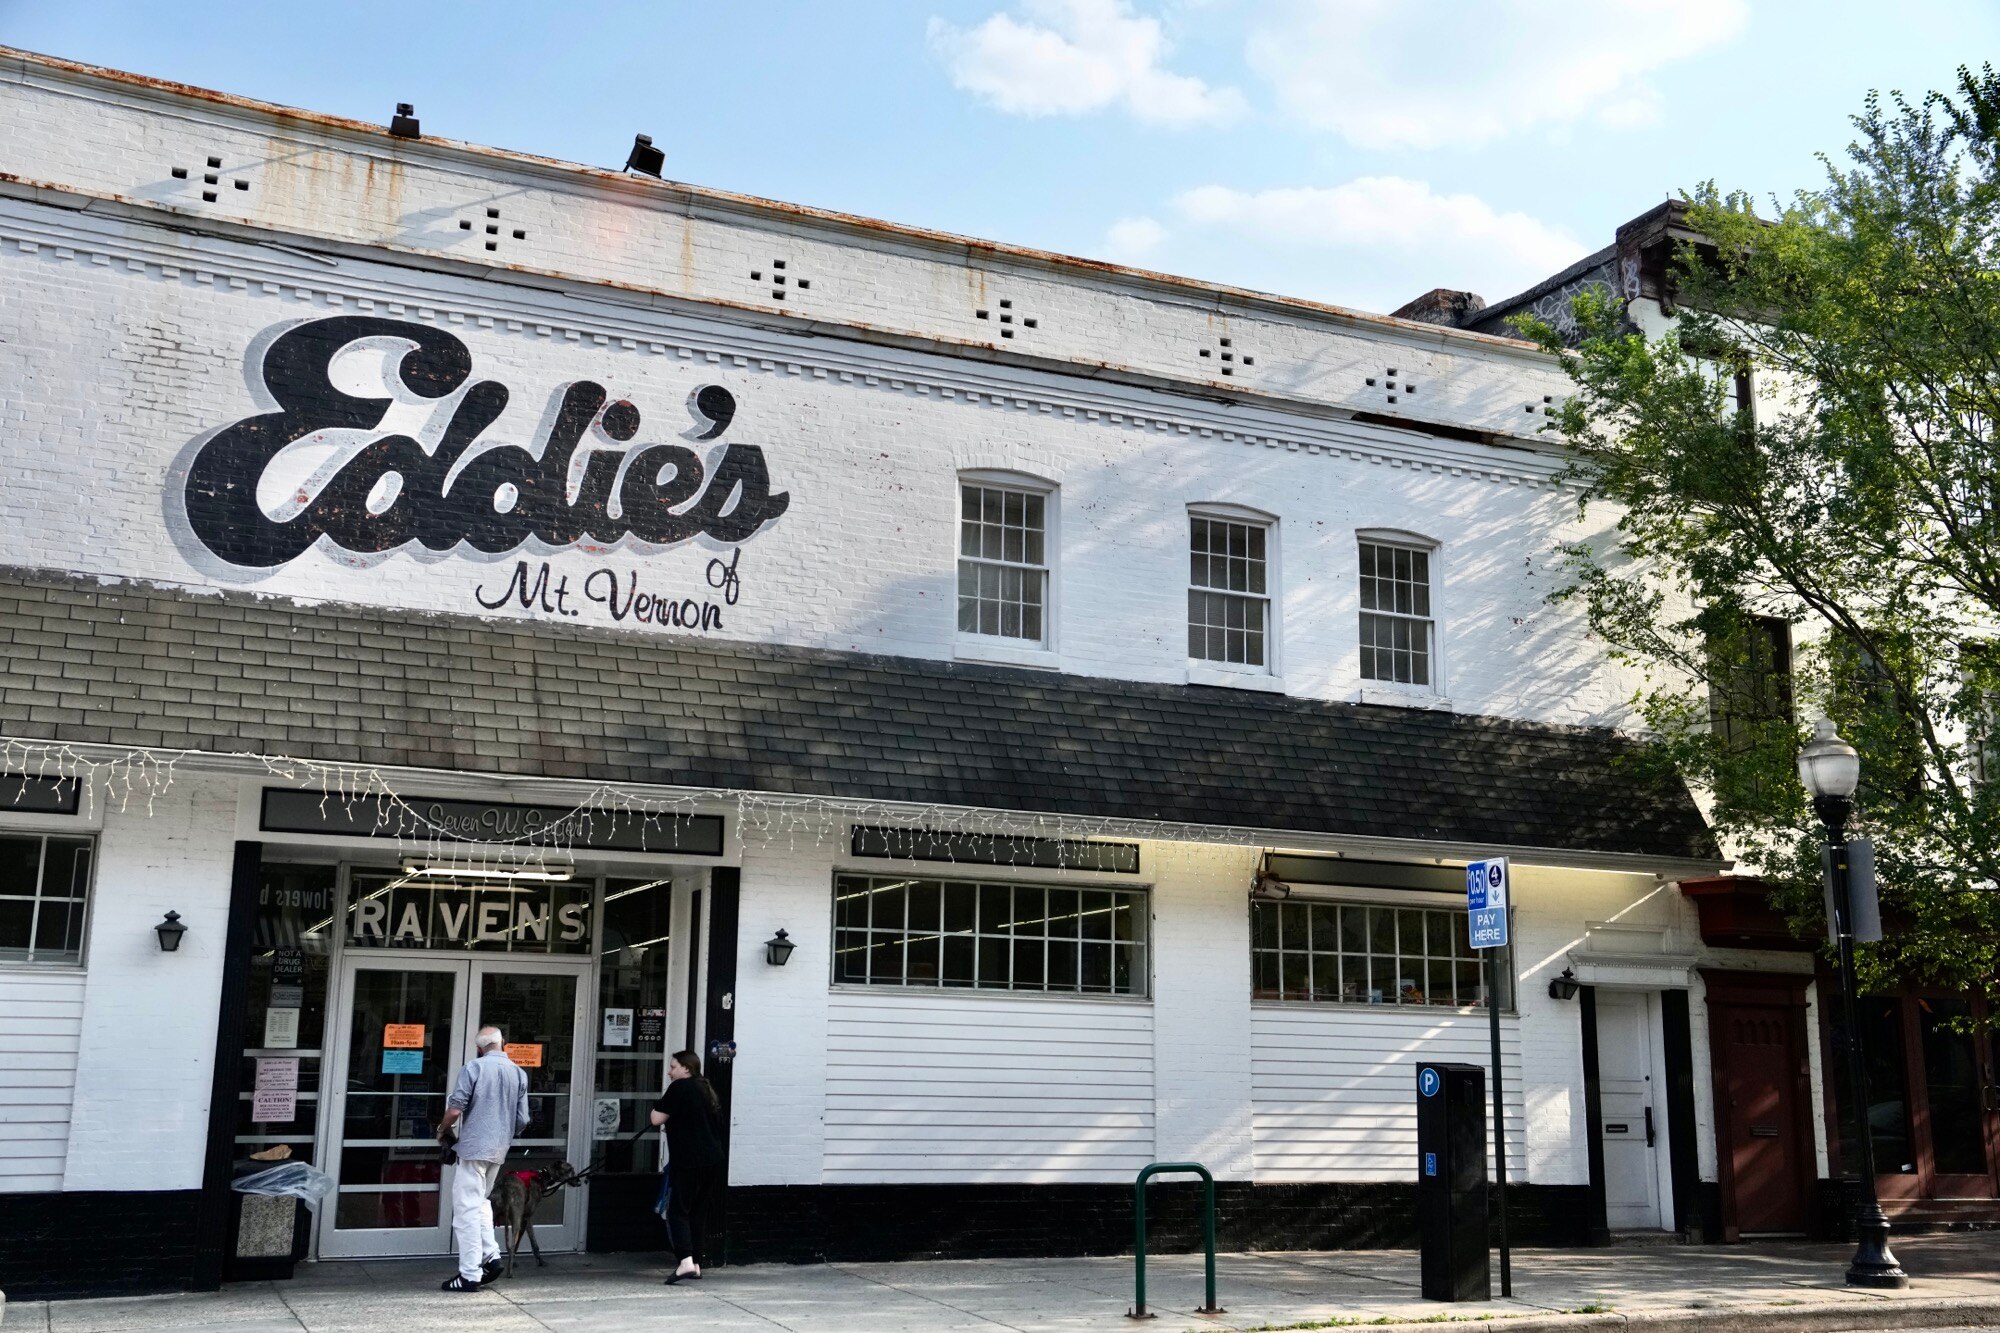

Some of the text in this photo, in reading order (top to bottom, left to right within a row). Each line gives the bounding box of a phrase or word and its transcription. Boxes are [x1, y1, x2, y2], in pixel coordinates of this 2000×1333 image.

[176, 315, 790, 573] Eddie's
[706, 547, 741, 605] of
[475, 560, 723, 631] Mt. Vernon
[427, 803, 582, 844] Seven W. Eager
[1491, 866, 1498, 879] 4
[356, 899, 586, 941] RAVENS
[1477, 914, 1496, 926] PAY
[1474, 928, 1500, 941] HERE
[278, 950, 294, 958] NOT
[274, 965, 303, 973] DEALER
[1424, 1073, 1434, 1092] P
[258, 1096, 293, 1104] CAUTION!
